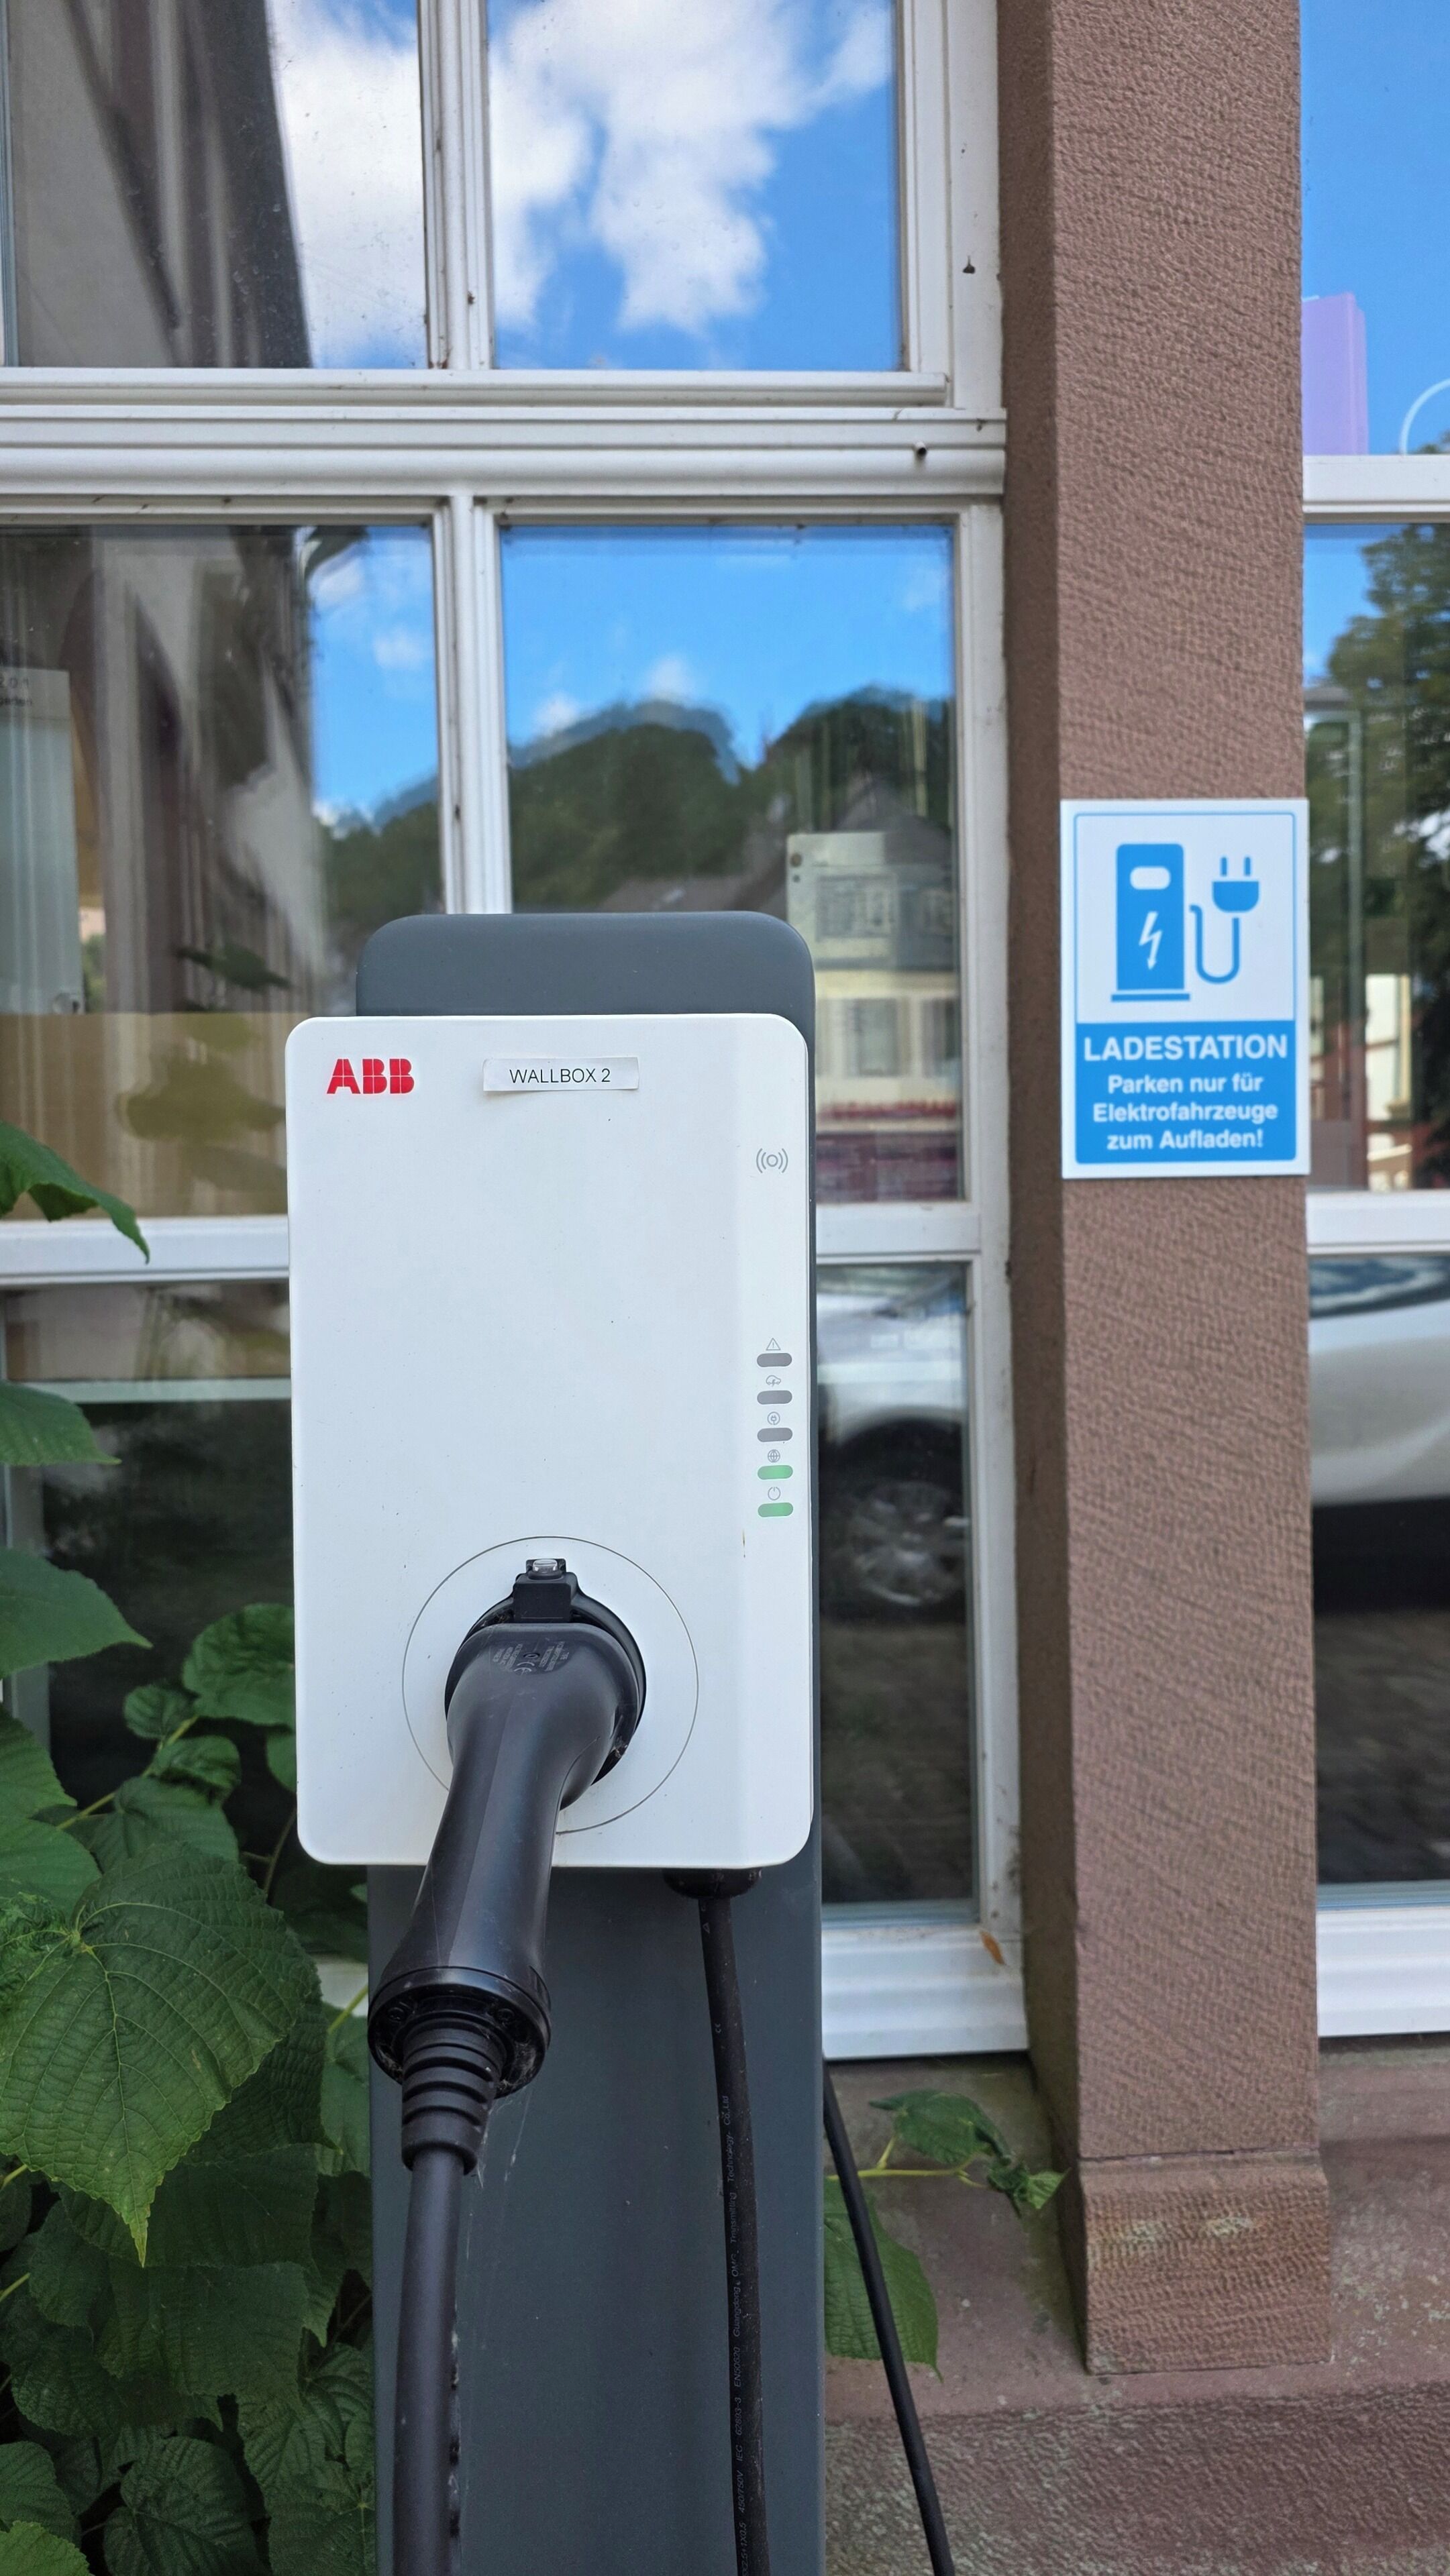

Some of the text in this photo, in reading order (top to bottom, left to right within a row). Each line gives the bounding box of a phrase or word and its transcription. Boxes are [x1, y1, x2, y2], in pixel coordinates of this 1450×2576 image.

[1084, 1033, 1288, 1061] LADESTATION
[327, 1059, 415, 1094] ABB
[509, 1068, 611, 1083] WALLBOX 2
[1108, 1073, 1264, 1094] Parken nur für
[1092, 1102, 1278, 1124] Elektrofahrzeuge
[1106, 1128, 1264, 1150] zum Aufladen!
[729, 2192, 737, 2244] Transmitting
[732, 2286, 741, 2337] Guangdong
[735, 2445, 743, 2462] IEC
